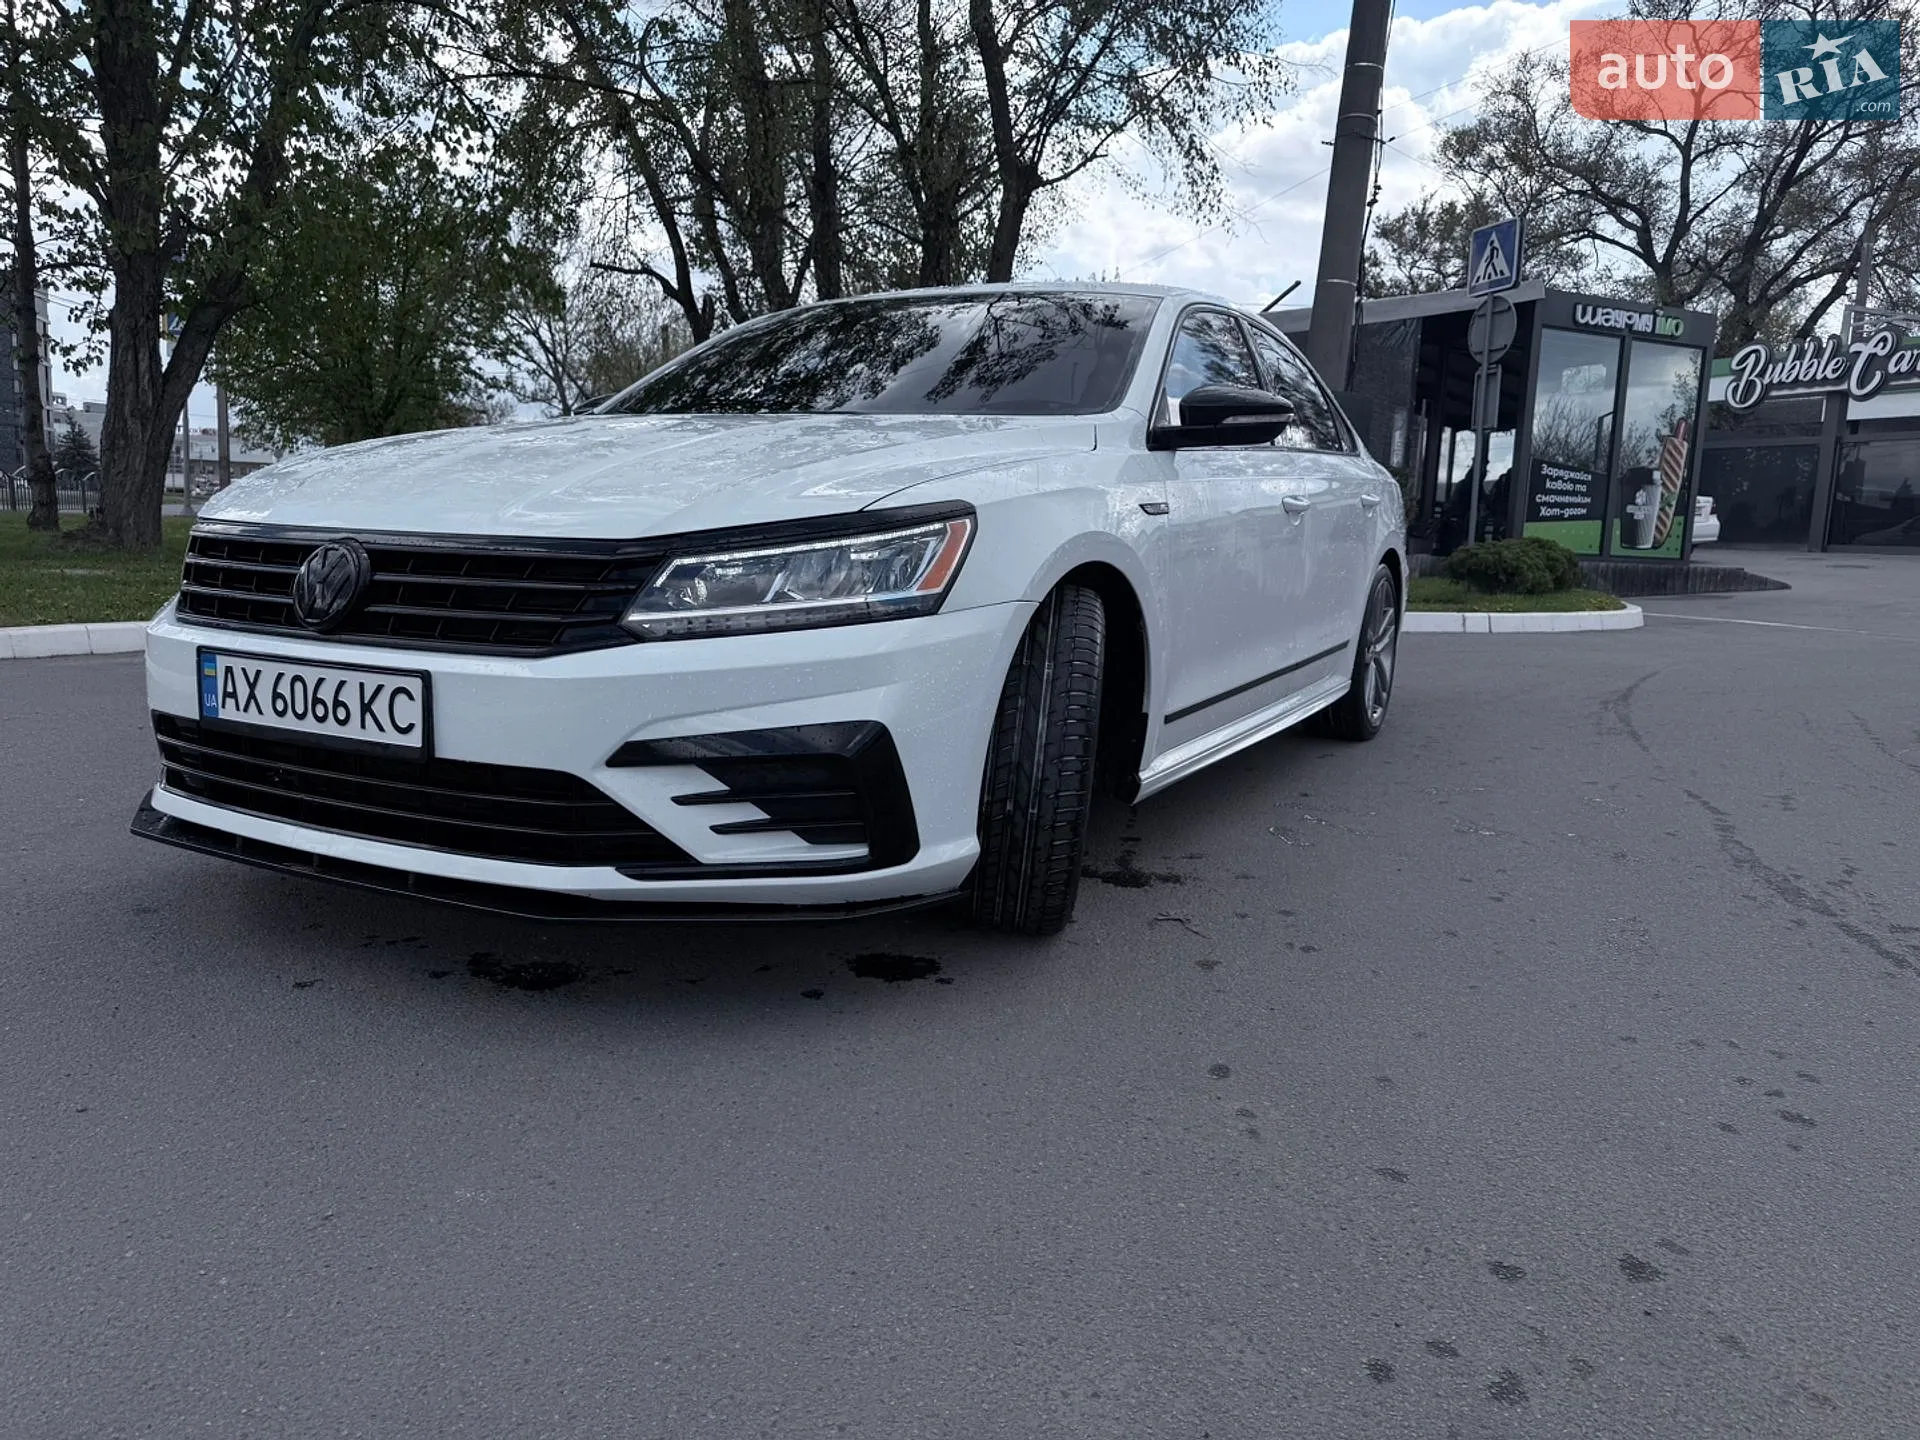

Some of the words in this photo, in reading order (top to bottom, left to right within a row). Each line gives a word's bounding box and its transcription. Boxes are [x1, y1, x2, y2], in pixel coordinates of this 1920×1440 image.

[1726, 338, 1848, 409] Bubble
[1575, 484, 1587, 492] та
[204, 692, 217, 708] UA
[221, 665, 264, 716] AX
[270, 671, 351, 727] 6066
[358, 681, 416, 735] KC
